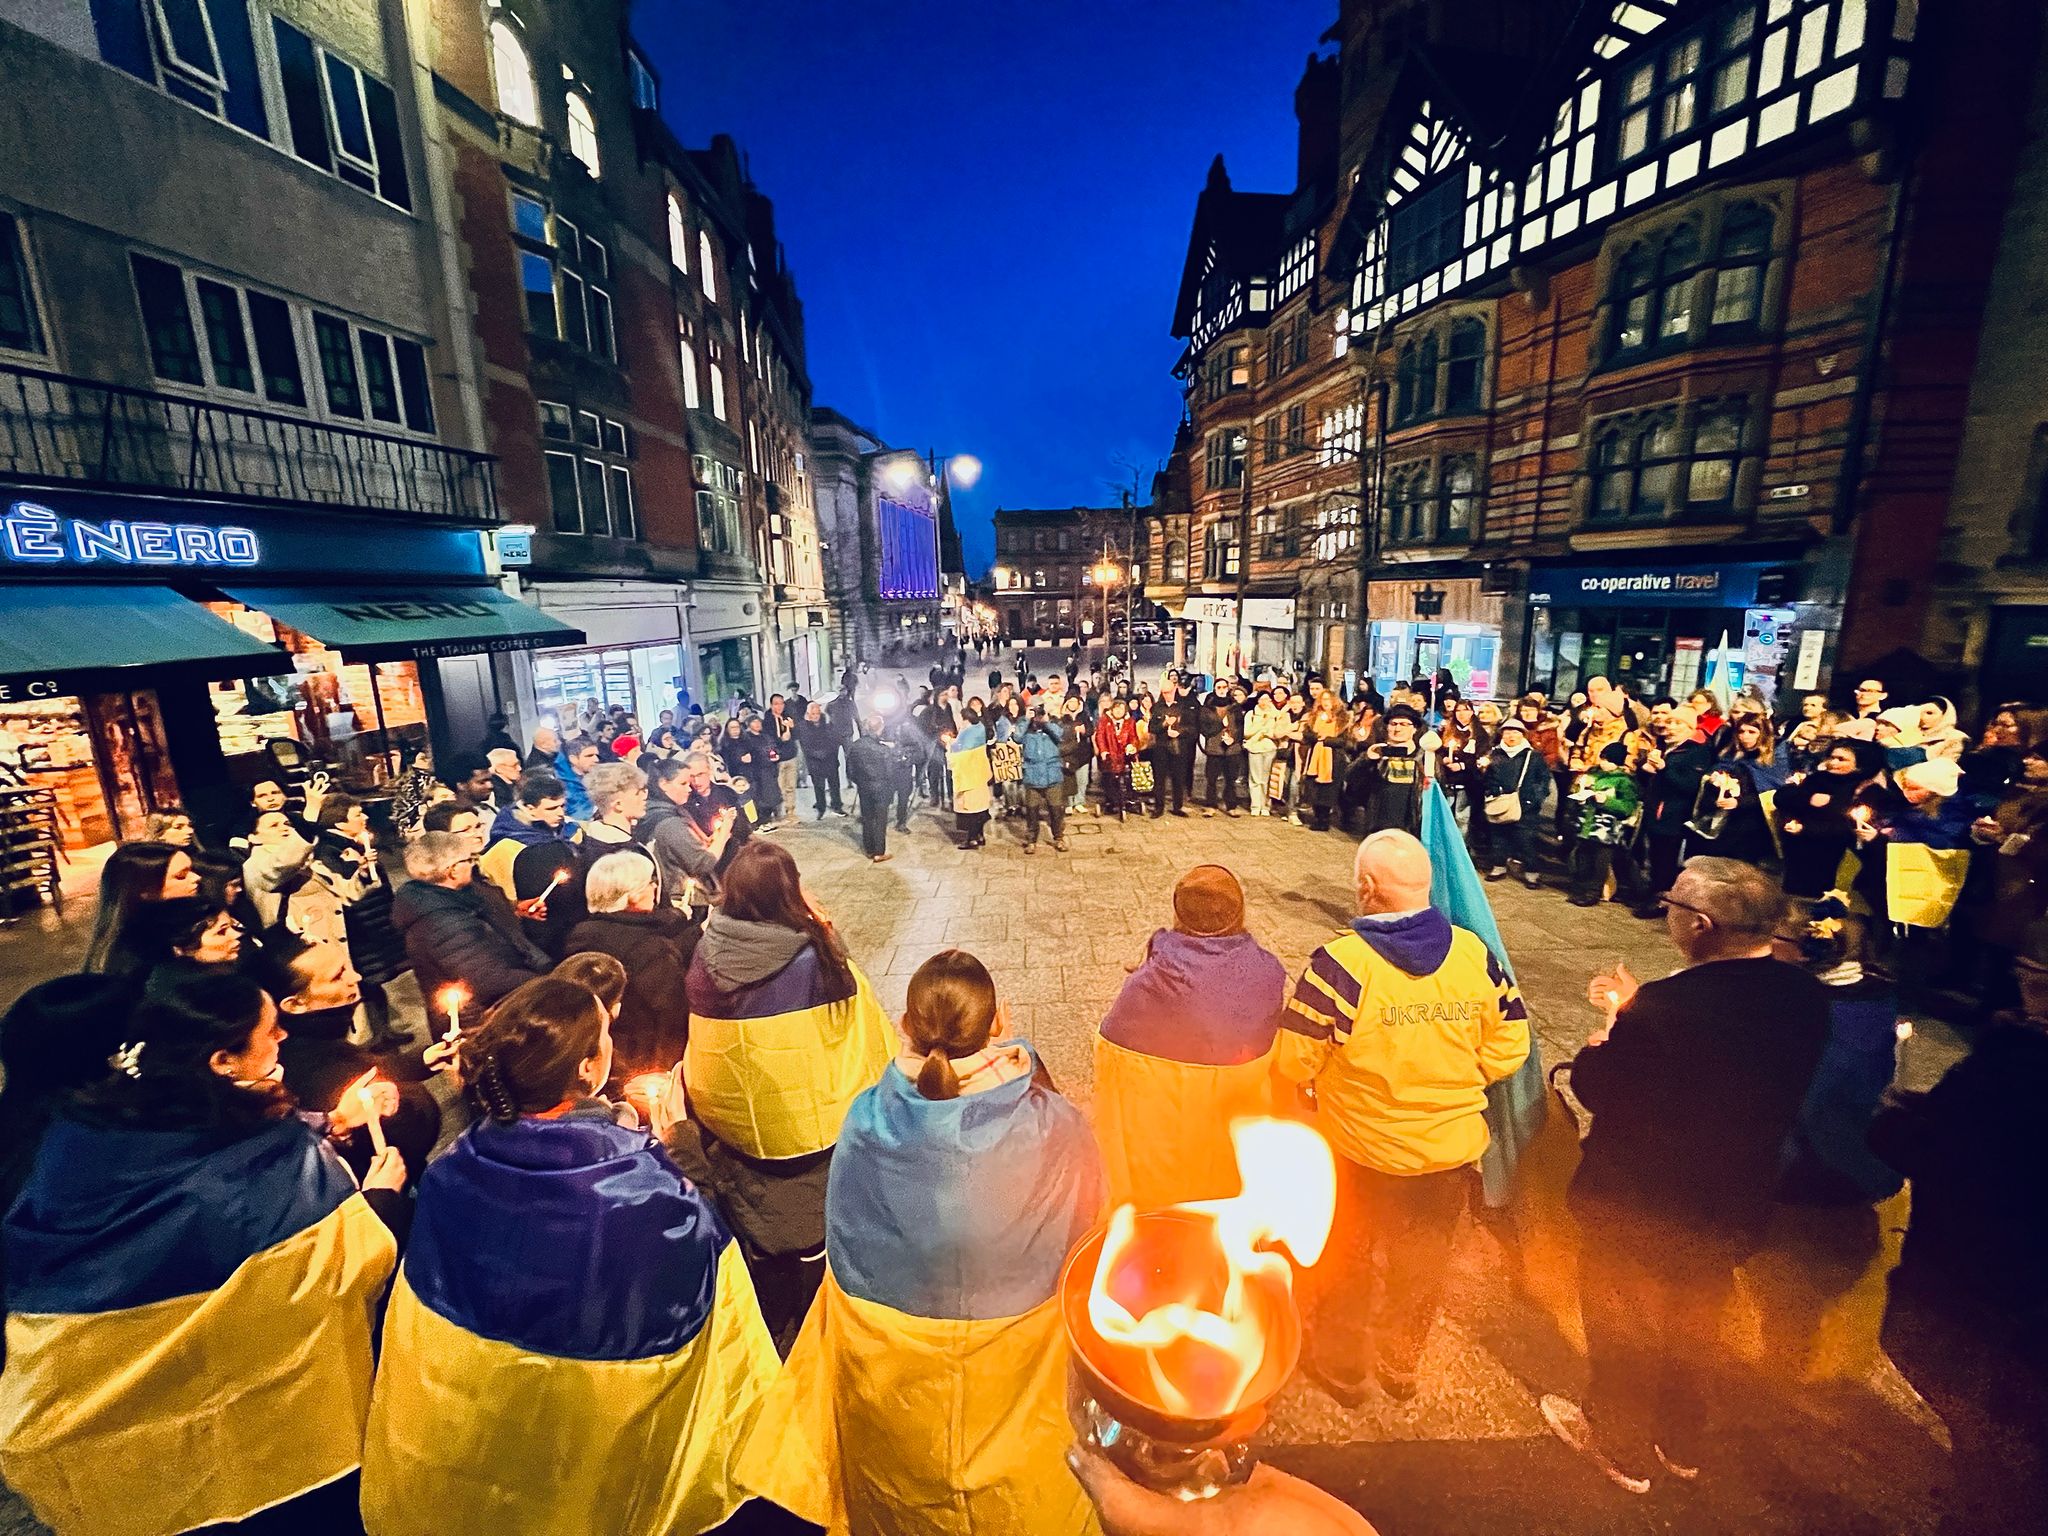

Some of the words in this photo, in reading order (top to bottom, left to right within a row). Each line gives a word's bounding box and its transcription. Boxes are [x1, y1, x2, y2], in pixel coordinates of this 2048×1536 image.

[70, 521, 259, 563] NERO
[1581, 573, 1671, 594] co-operative
[1675, 571, 1720, 589] travel
[331, 602, 500, 622] NERO
[412, 646, 436, 658] THE
[442, 643, 487, 655] ITALIAN
[490, 639, 529, 651] COFFEE
